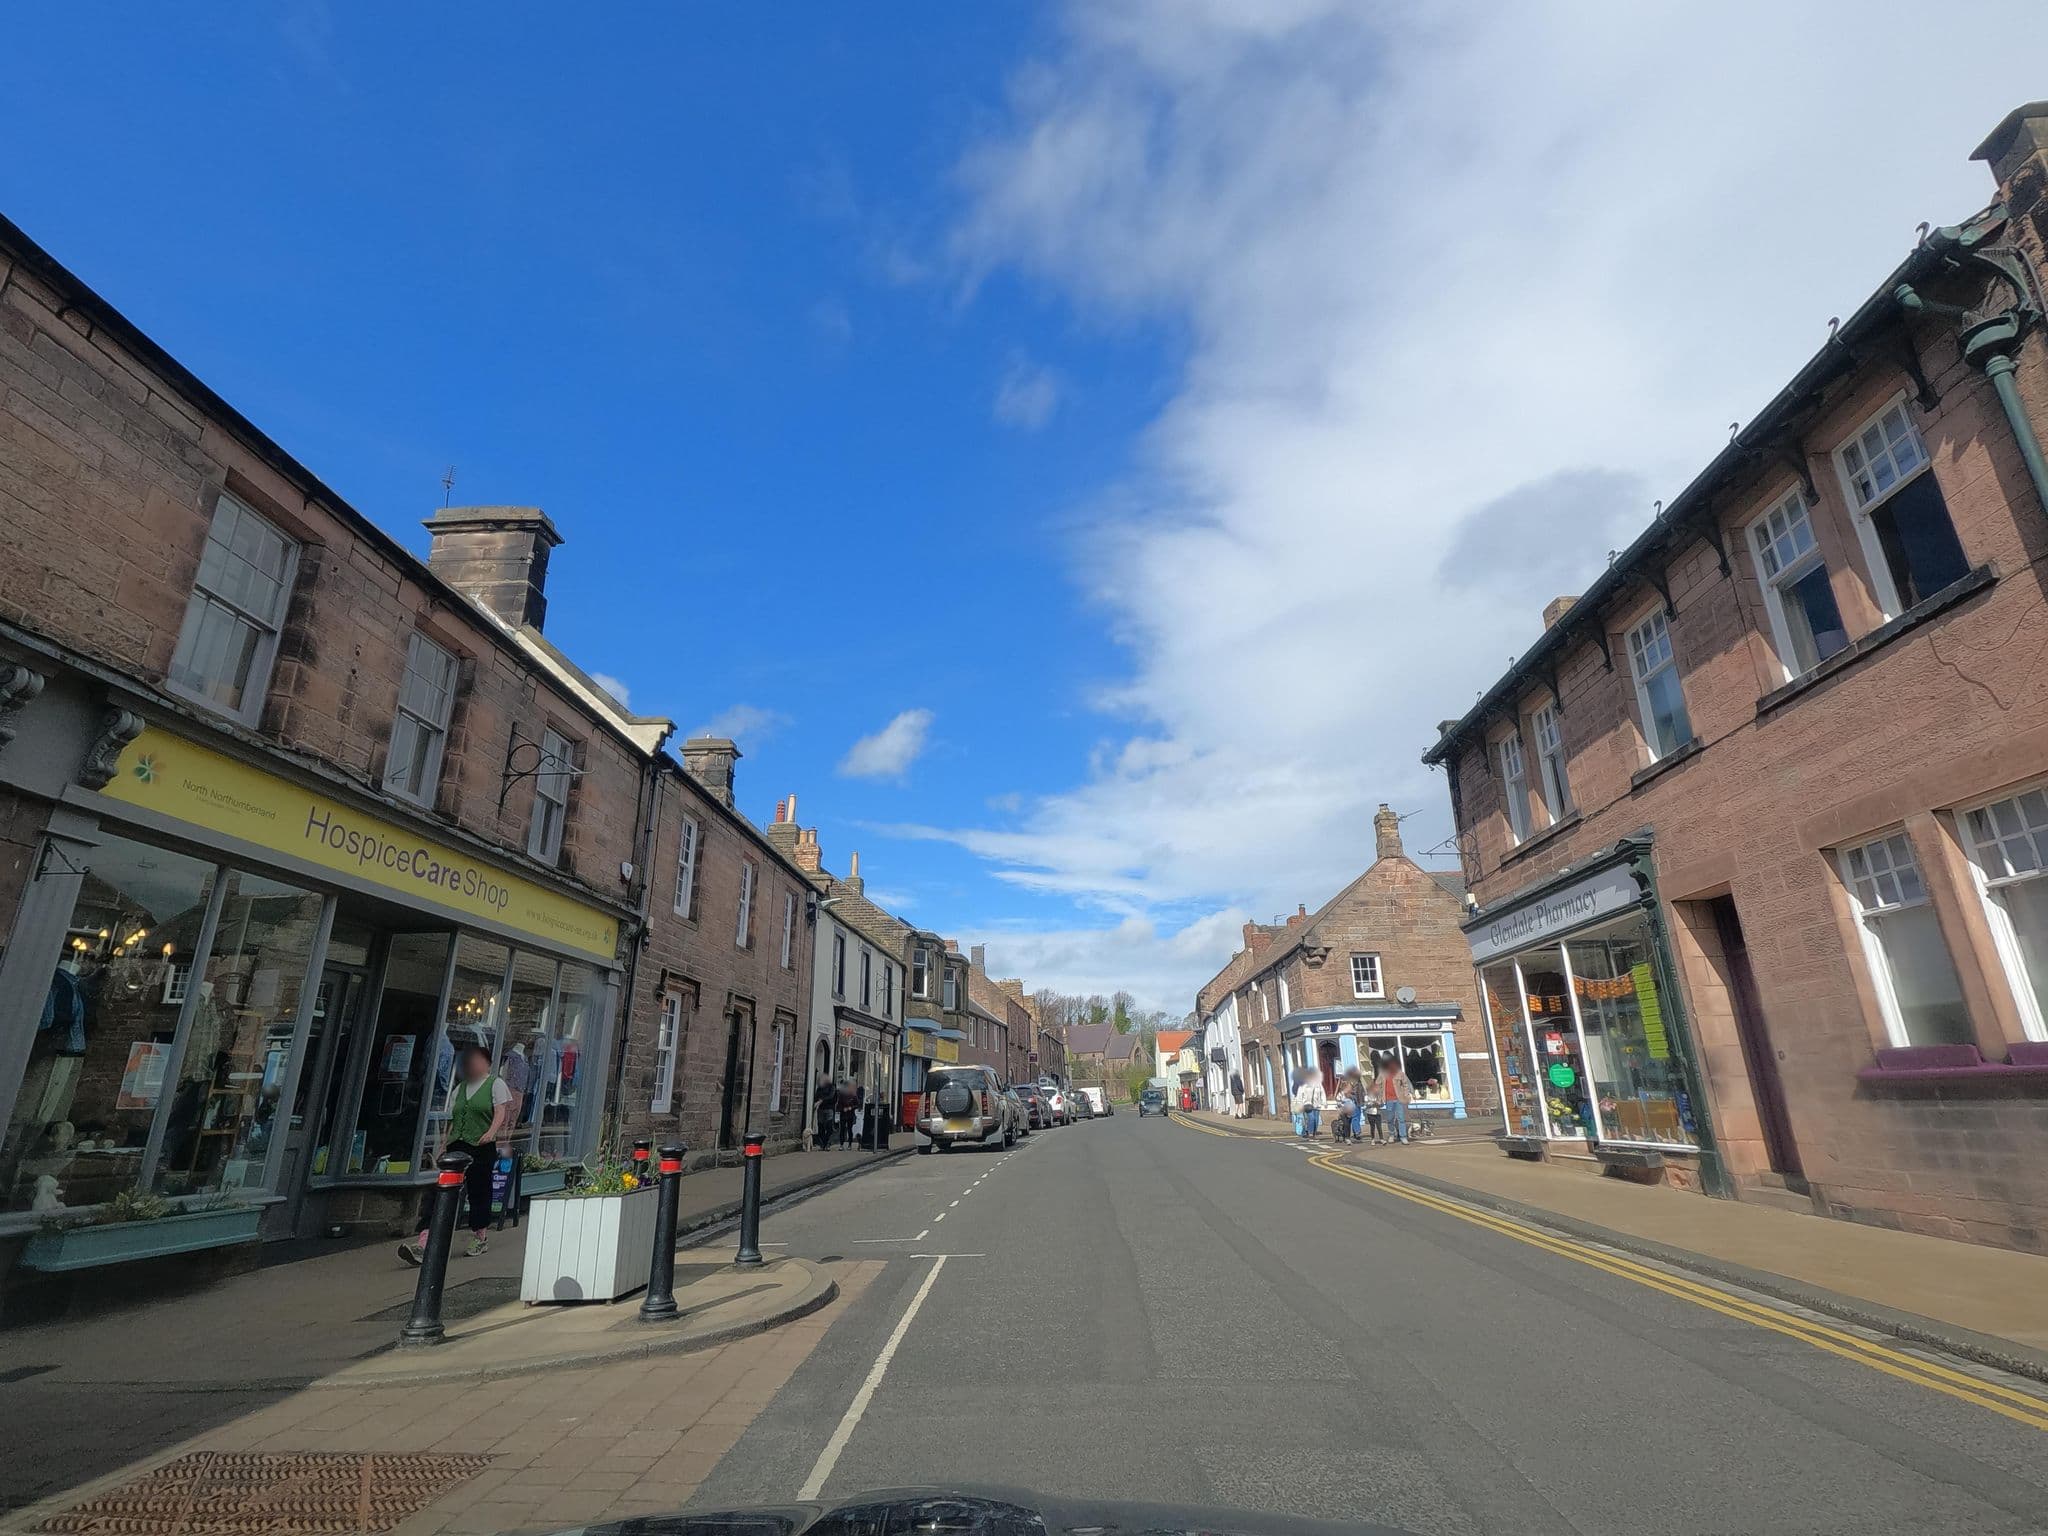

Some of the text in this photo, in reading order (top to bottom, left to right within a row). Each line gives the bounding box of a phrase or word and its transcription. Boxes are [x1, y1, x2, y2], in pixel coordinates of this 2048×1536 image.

[182, 779, 208, 797] North
[210, 790, 276, 820] Northumberland
[463, 868, 509, 913] Shop
[1490, 887, 1598, 947] Glendale Pharmacy
